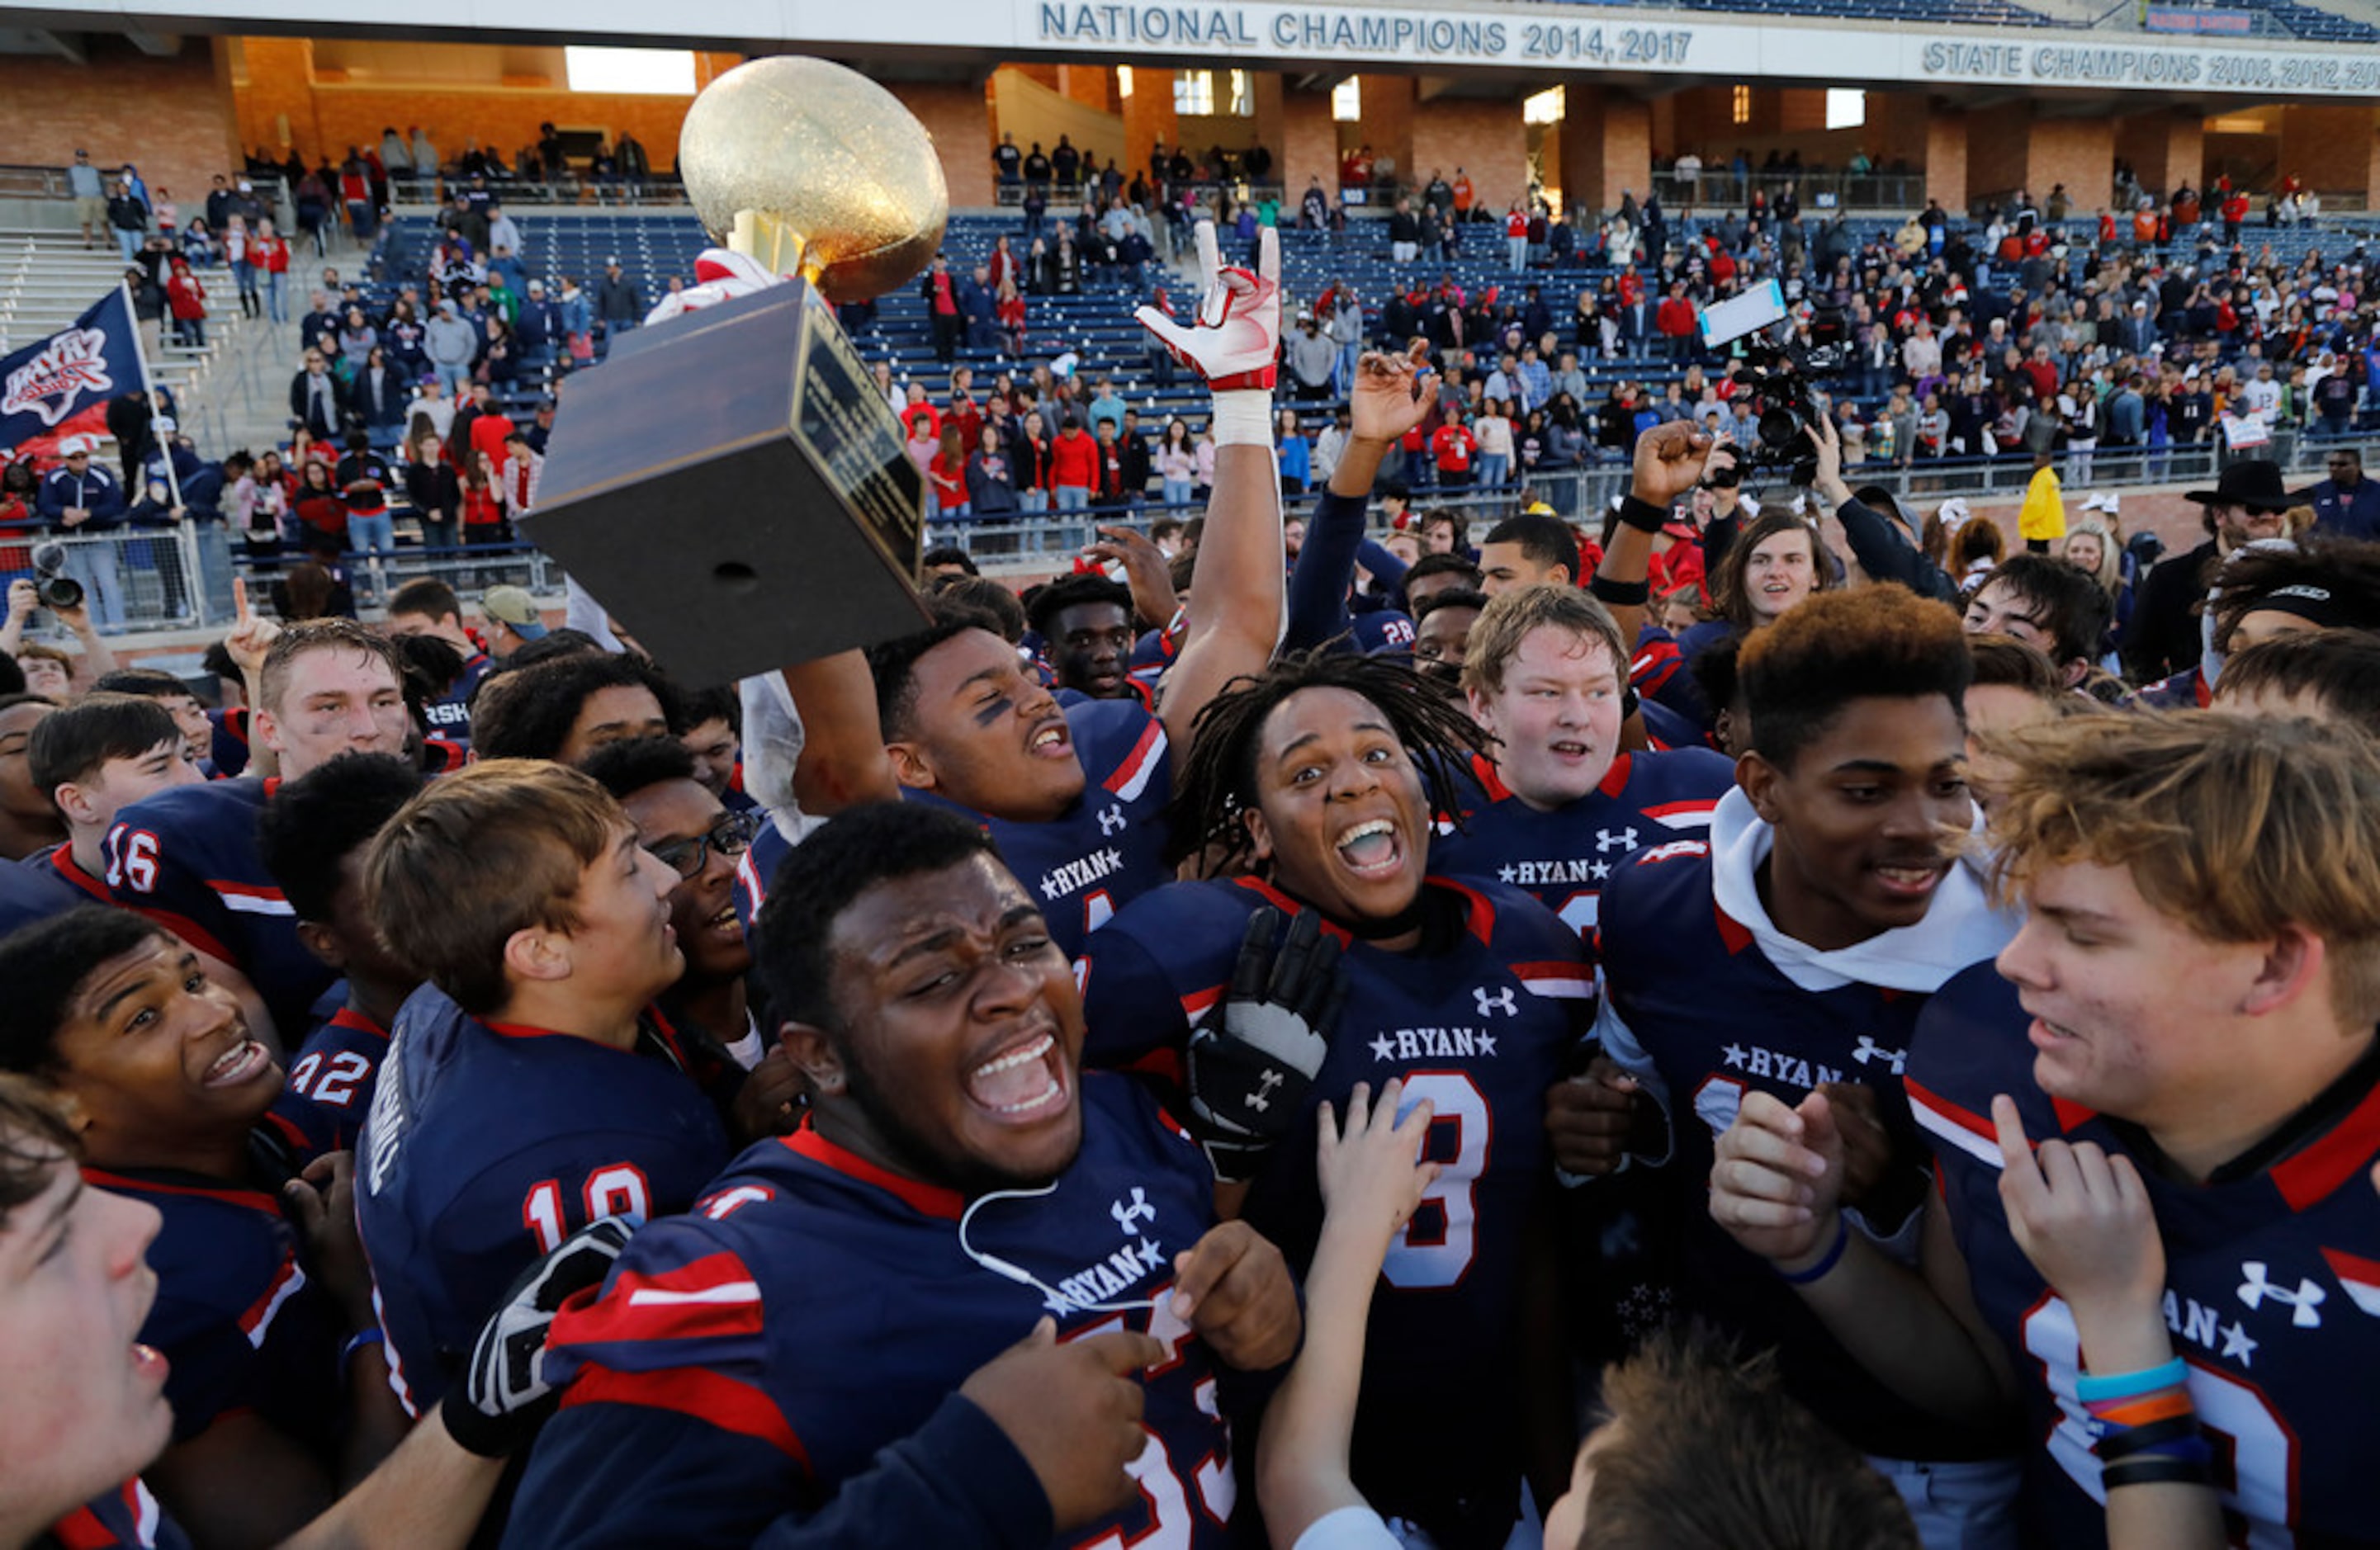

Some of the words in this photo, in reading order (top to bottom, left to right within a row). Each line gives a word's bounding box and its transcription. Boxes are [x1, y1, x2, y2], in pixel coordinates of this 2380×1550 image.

[1041, 2, 1258, 44] NATIONAL
[1273, 12, 1507, 53] CHAMPIONS
[1625, 28, 1693, 59] 2017
[1926, 42, 2023, 73] STATE
[2035, 47, 2202, 80] CHAMPIONS
[105, 823, 161, 894] 16
[1052, 849, 1110, 896] RYAN
[1516, 860, 1589, 885] RYAN
[1395, 1028, 1475, 1059] RYAN
[1747, 1046, 1843, 1089] RYAN
[1059, 1244, 1147, 1308] RYAN
